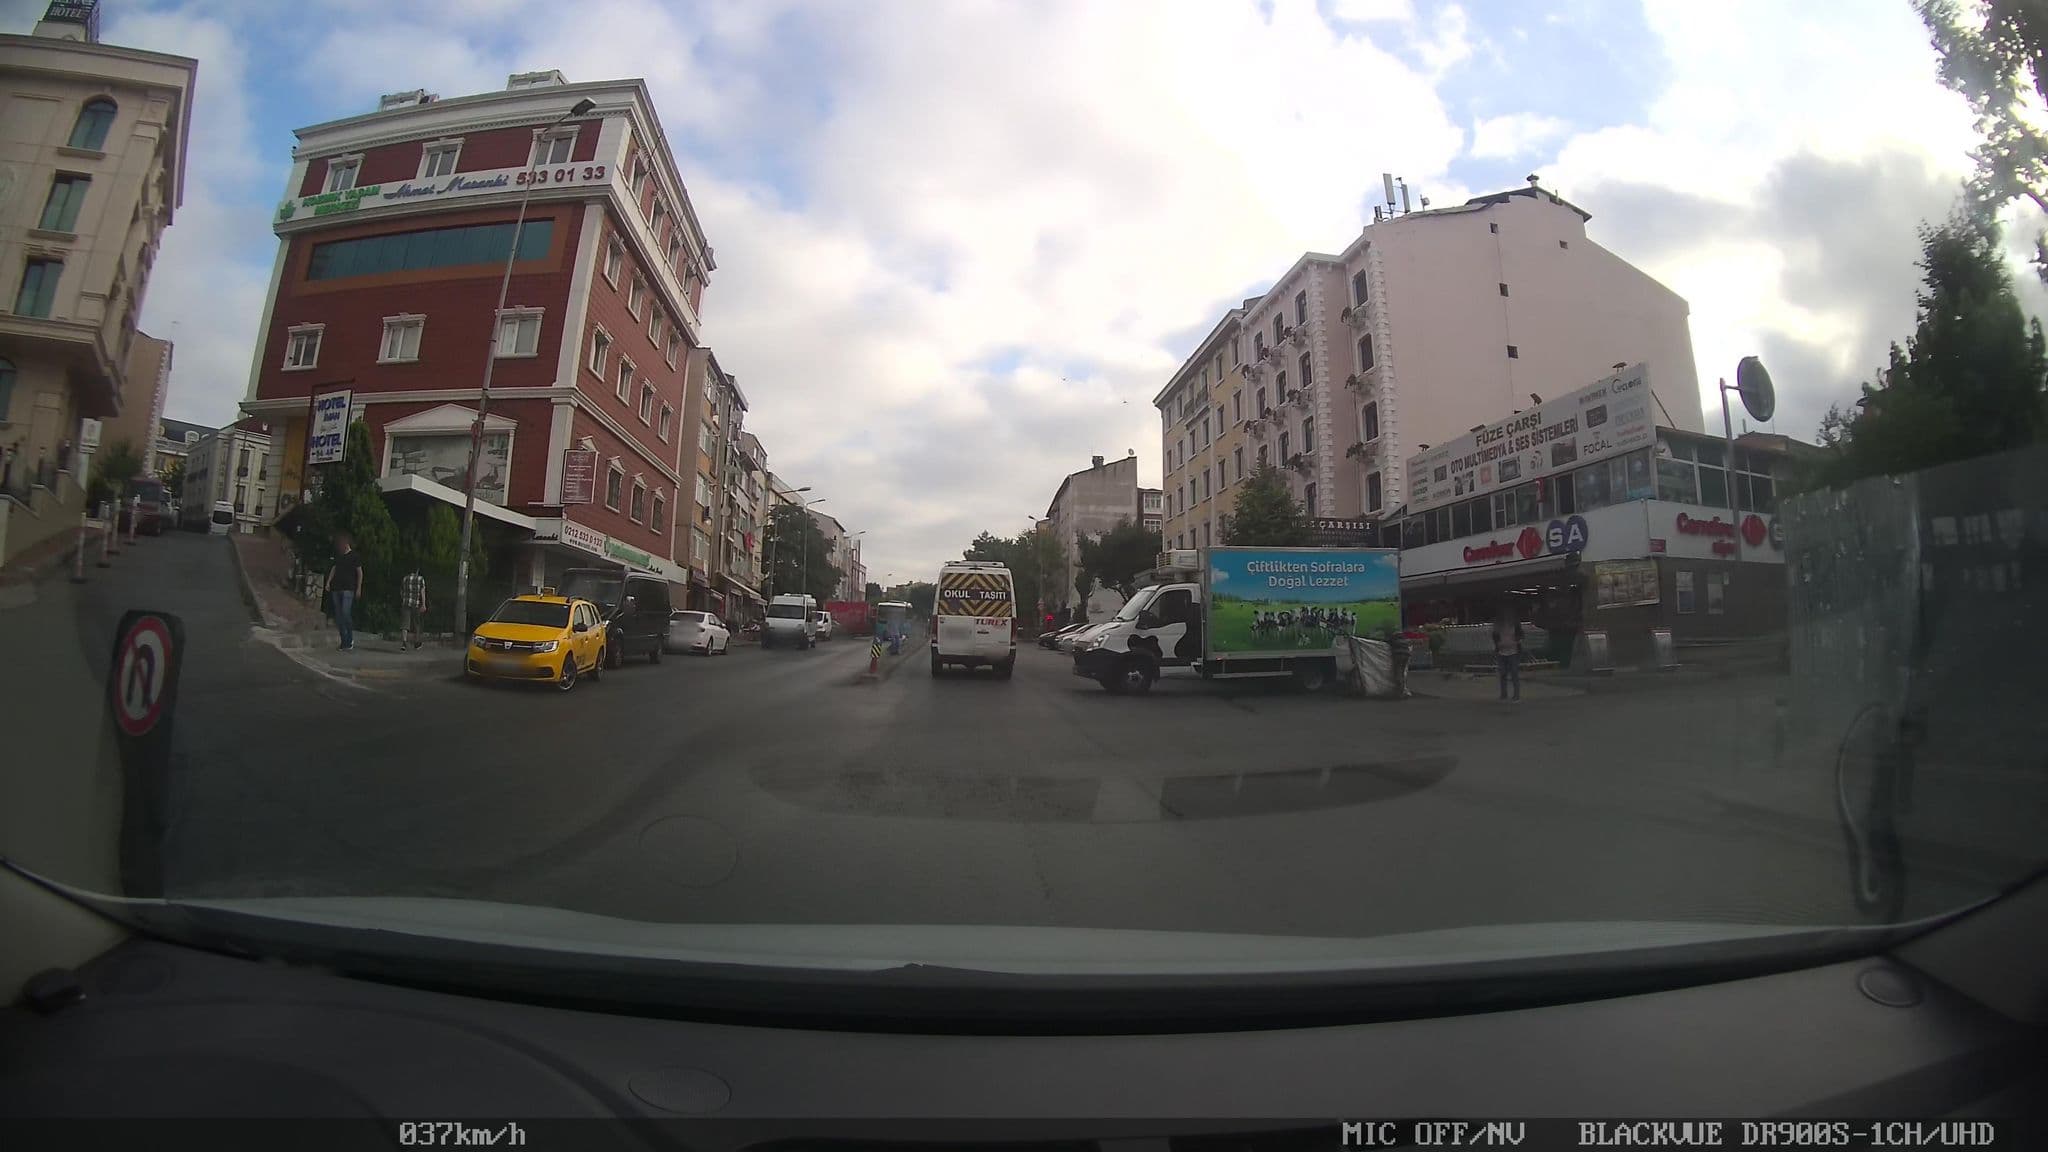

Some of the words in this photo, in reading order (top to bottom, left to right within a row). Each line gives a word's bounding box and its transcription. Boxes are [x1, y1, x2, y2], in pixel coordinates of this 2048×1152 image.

[50, 7, 83, 18] HOTEL
[516, 170, 548, 185] 533
[554, 163, 575, 183] 01
[583, 161, 606, 180] 33
[1476, 426, 1504, 447] FÜZE
[1506, 411, 1542, 438] ÇARŞI
[311, 433, 343, 449] HOTEL
[1450, 457, 1464, 474] OTO
[1515, 433, 1530, 453] SES
[1247, 561, 1307, 575] Çiftlikten
[1311, 561, 1365, 573] Sofralara
[1268, 576, 1306, 589] Doğal
[1309, 576, 1350, 587] Lezzet
[944, 589, 971, 599] OKUL
